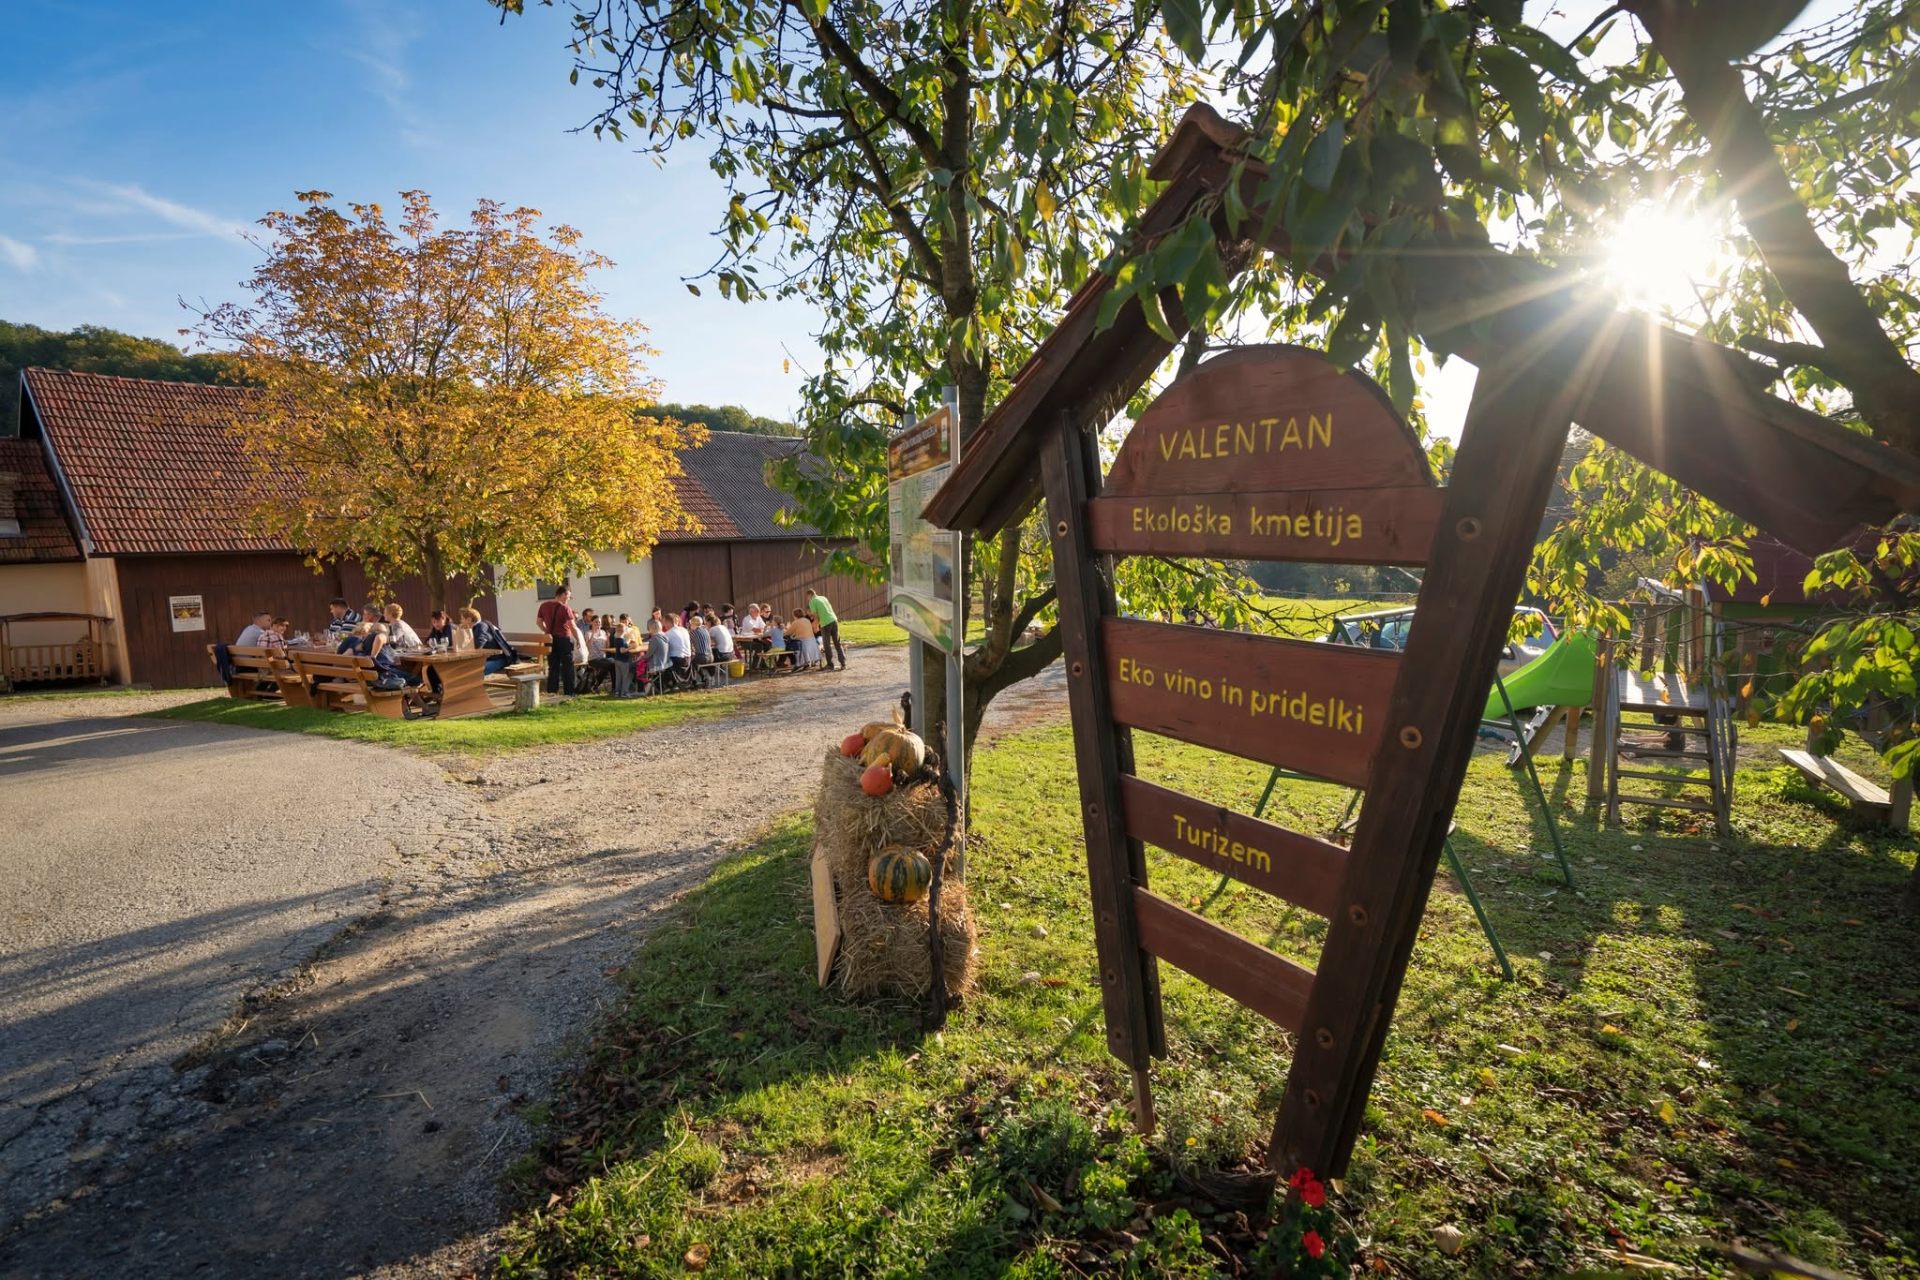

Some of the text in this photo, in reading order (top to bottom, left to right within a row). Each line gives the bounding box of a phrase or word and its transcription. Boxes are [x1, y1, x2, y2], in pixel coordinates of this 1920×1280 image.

[1159, 412, 1333, 462] VALENTAN
[1132, 504, 1363, 547] Ekološka kmetija
[1119, 657, 1363, 735] Eko vino in pridelki
[1172, 813, 1272, 874] Turizem
